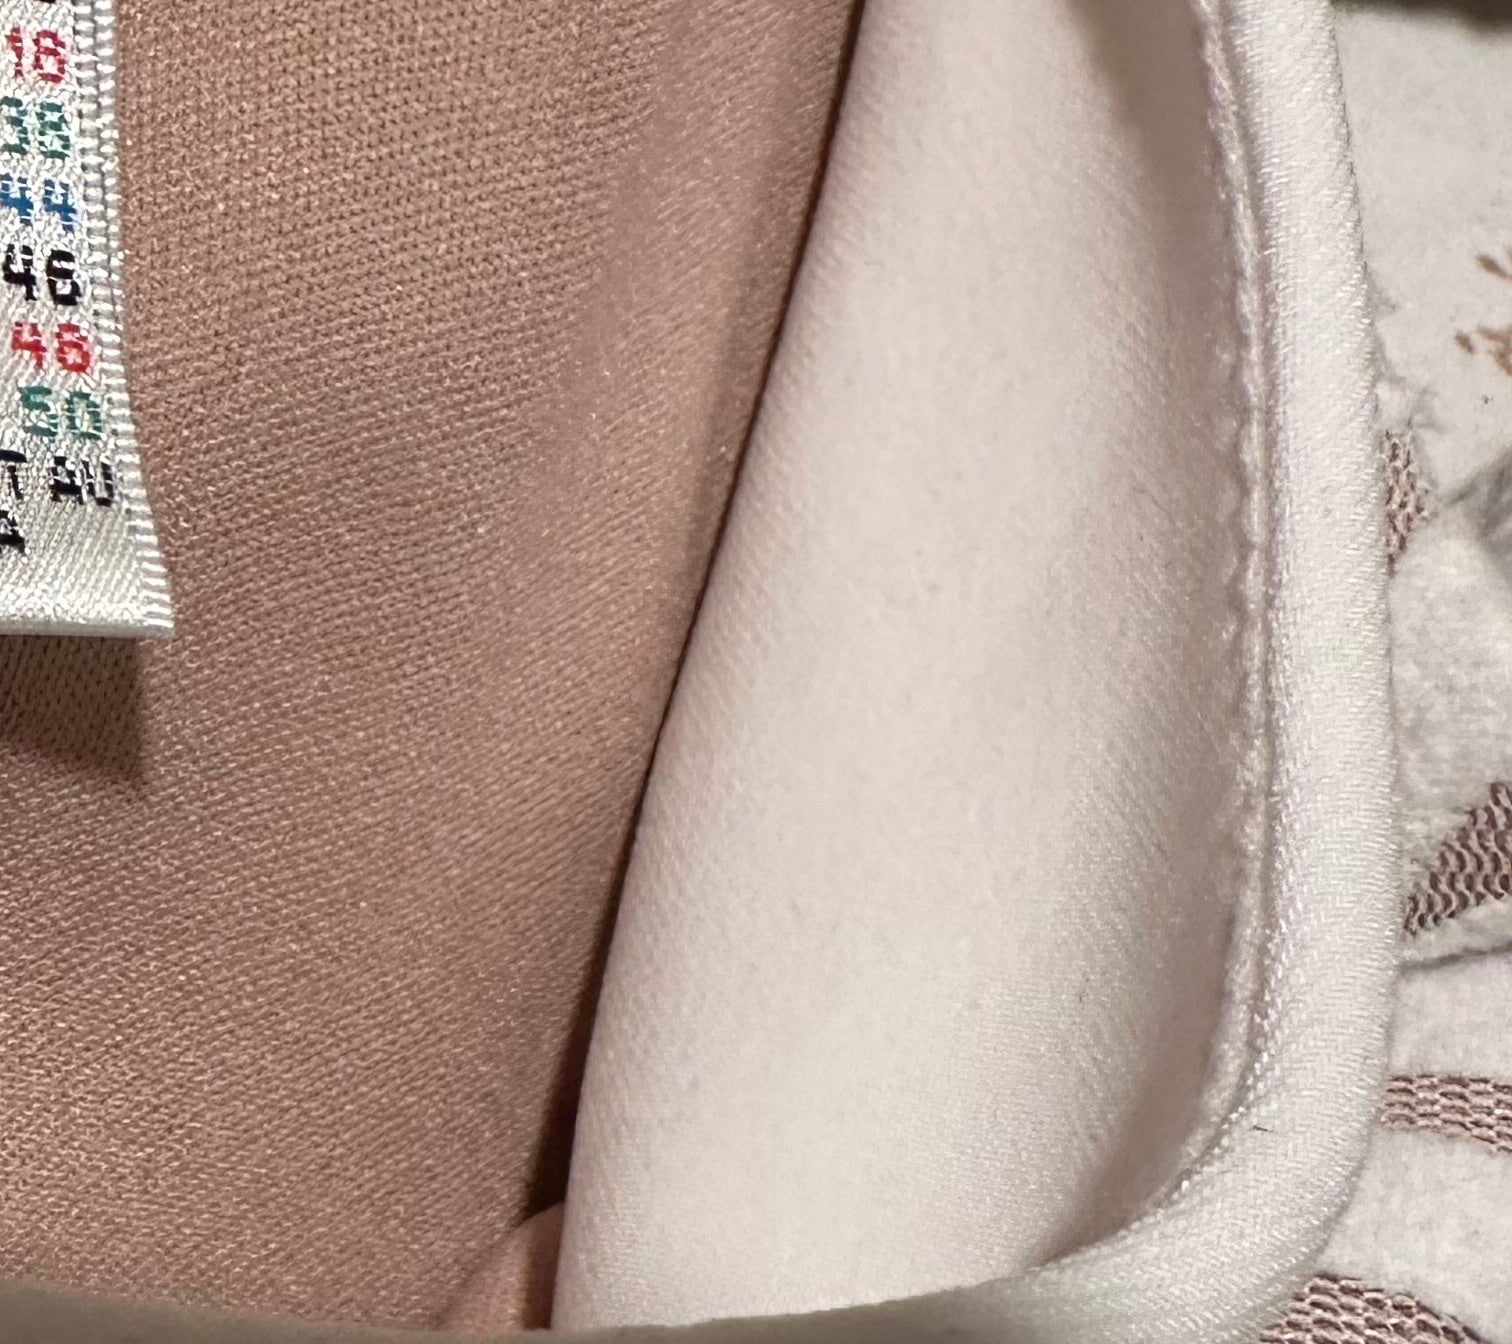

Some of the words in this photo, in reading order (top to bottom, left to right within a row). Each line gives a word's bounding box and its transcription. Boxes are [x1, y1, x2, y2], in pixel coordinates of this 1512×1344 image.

[6, 25, 67, 83] 18
[0, 96, 71, 158] 38
[2, 243, 82, 305] 46
[11, 320, 91, 373] 48
[18, 385, 103, 441] 50
[49, 456, 113, 506] AU
